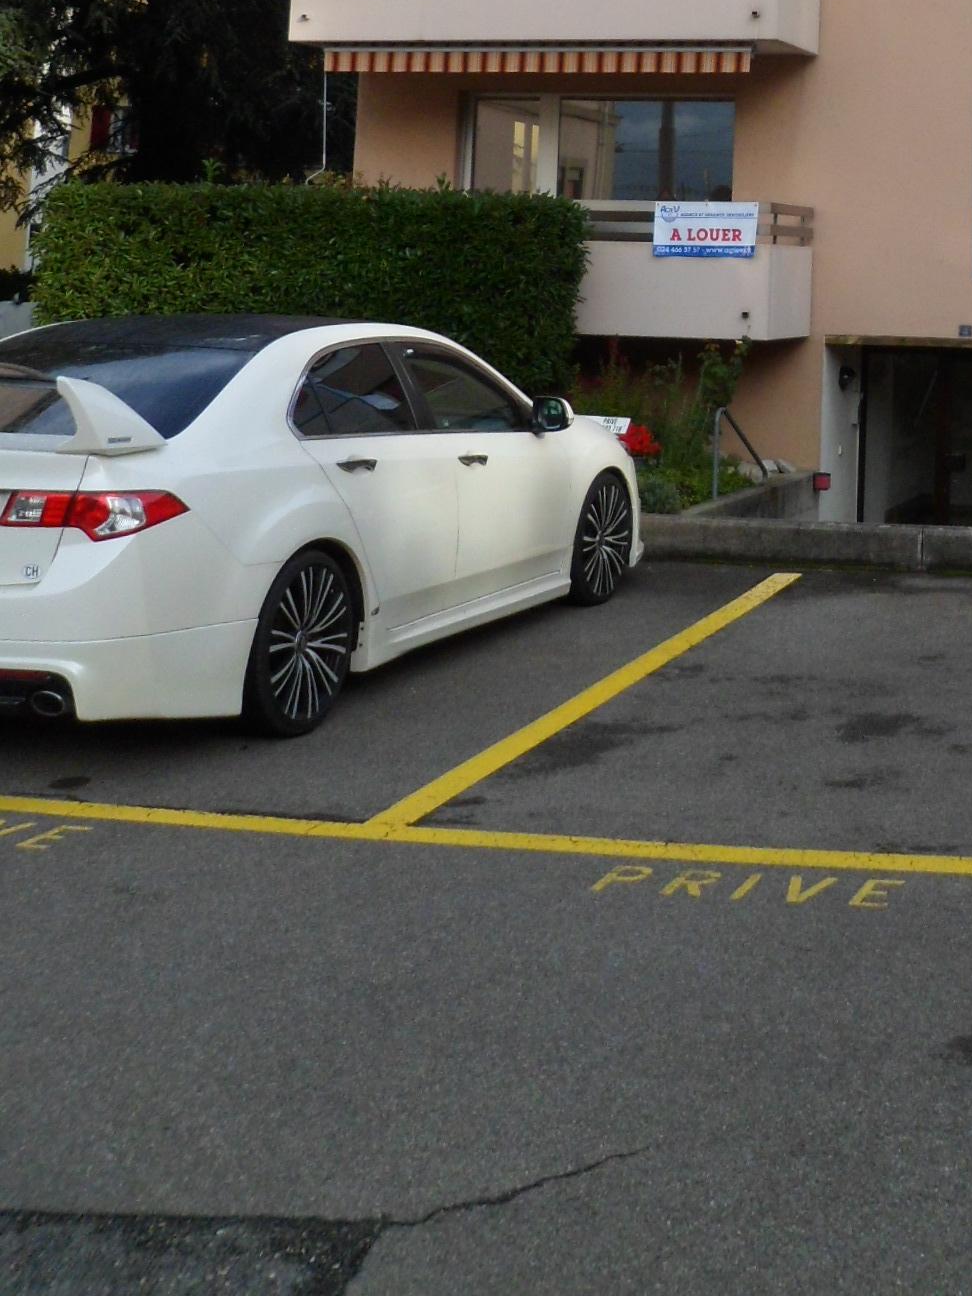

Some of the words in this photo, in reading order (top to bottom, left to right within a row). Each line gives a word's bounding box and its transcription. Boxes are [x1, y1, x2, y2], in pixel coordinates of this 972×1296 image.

[670, 228, 682, 242] A
[686, 228, 742, 242] LOUER
[25, 565, 39, 578] CH
[590, 864, 907, 909] PRIVE
